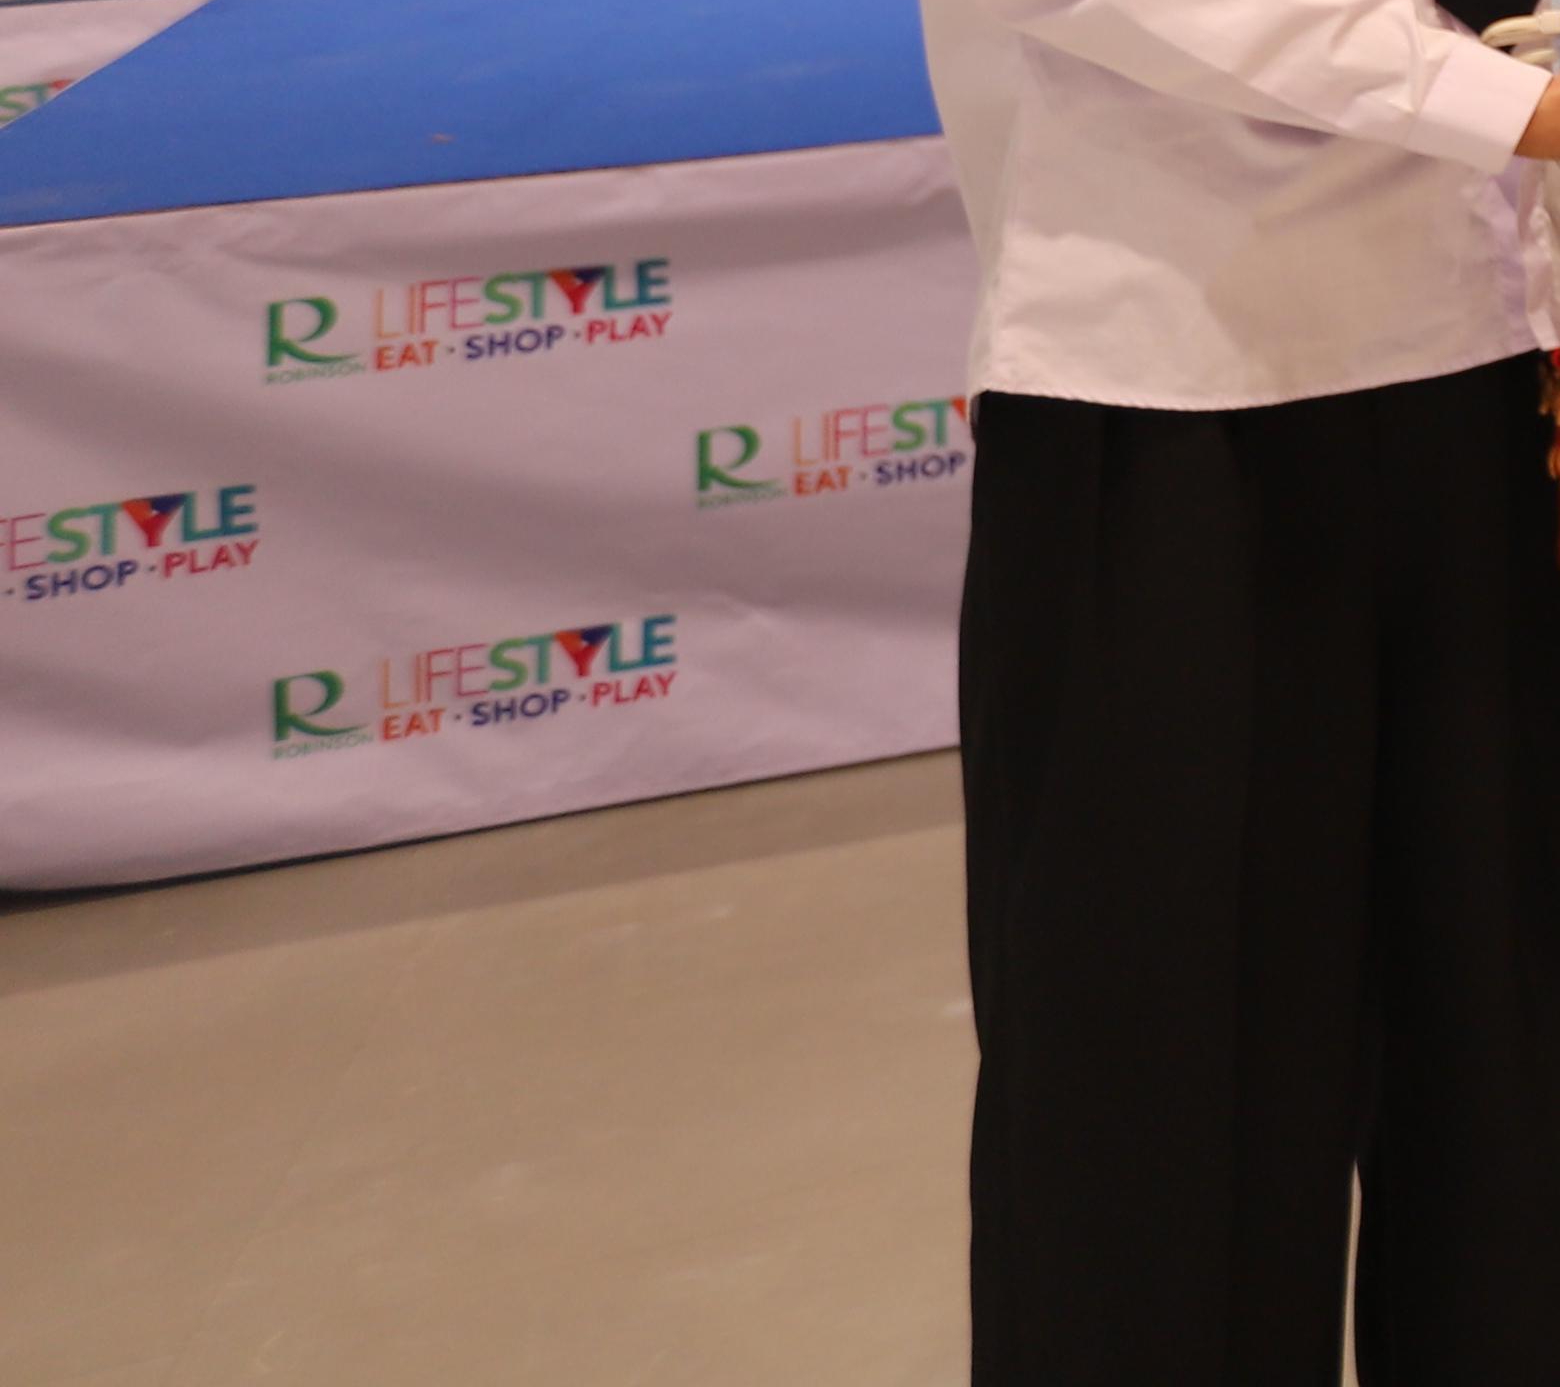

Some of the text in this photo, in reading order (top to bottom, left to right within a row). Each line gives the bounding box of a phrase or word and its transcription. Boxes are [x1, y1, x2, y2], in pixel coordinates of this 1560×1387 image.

[265, 258, 672, 368] R LIFESTYLE
[375, 311, 672, 372] EAT SHOP PLAY
[695, 424, 779, 492] R
[793, 452, 966, 497] EAT SHOP
[26, 538, 260, 601] SHOP PLAY
[272, 614, 678, 742] R LIFESTYLE
[382, 671, 678, 742] EAT SHOP PLAY
